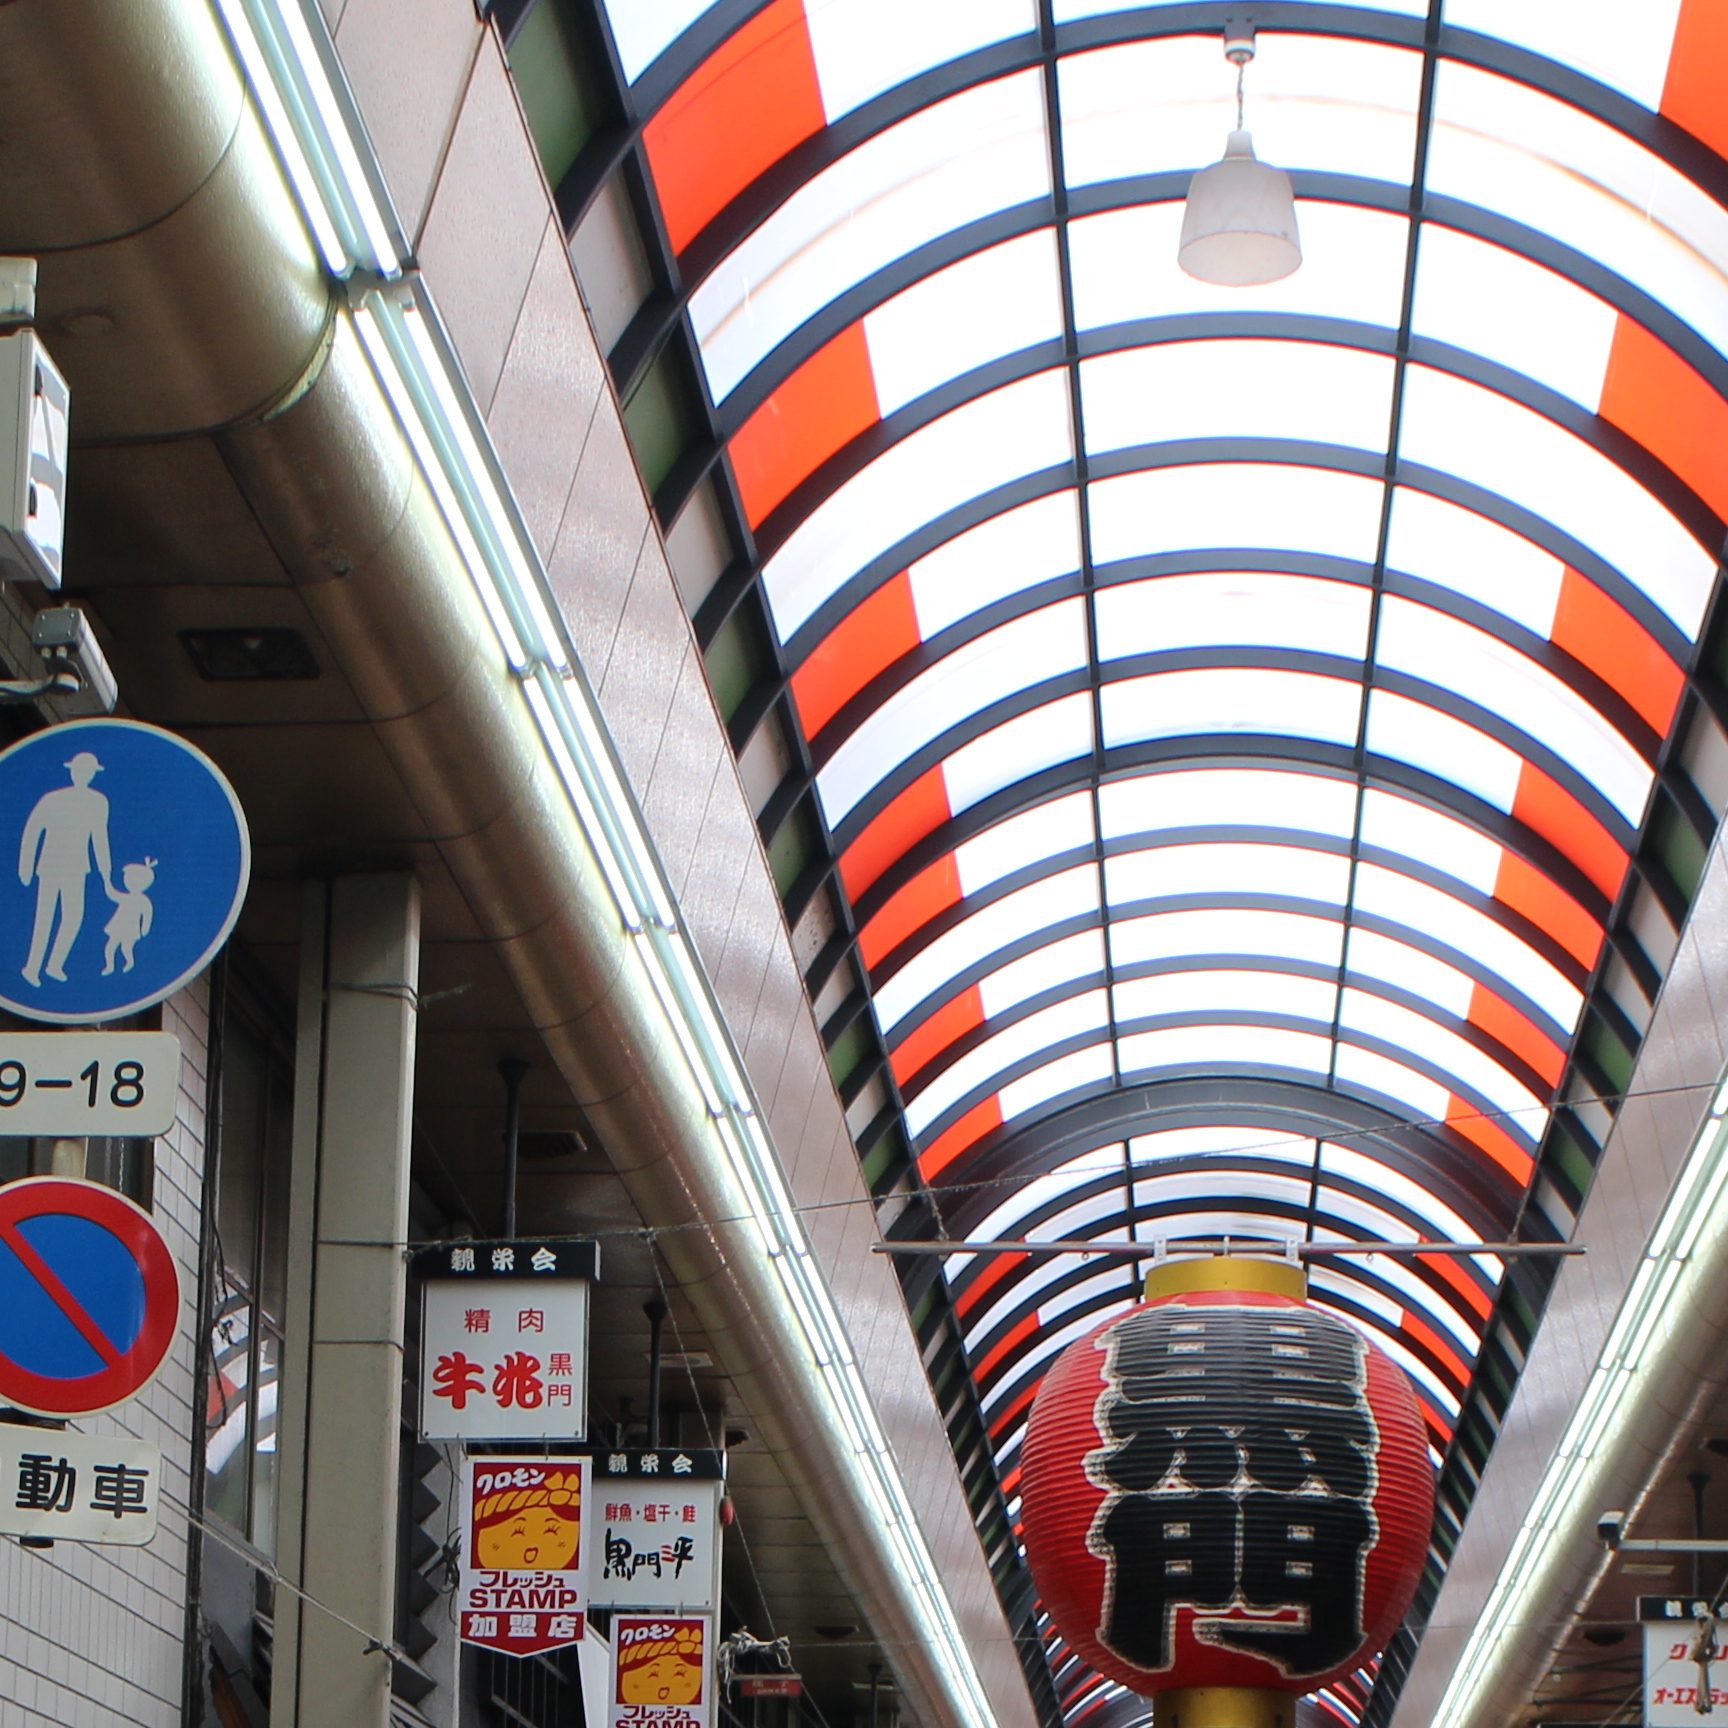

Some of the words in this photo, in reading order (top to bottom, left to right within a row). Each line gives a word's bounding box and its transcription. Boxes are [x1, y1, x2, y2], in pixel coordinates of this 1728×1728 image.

[450, 1248, 557, 1272] 親栄会
[463, 1307, 546, 1334] 精肉
[547, 1353, 573, 1407] 黒門
[608, 1454, 693, 1474] 親栄会
[475, 1467, 546, 1494] クロモン
[1082, 1304, 1380, 1679] 黒門
[604, 1502, 697, 1524] 鮮魚・塩干・鮭
[478, 1570, 566, 1589] フレッシュ
[468, 1589, 579, 1610] STAMP
[467, 1613, 578, 1639] 加盟店
[619, 1623, 676, 1645] クロモン
[622, 1704, 691, 1720] フレッシュ
